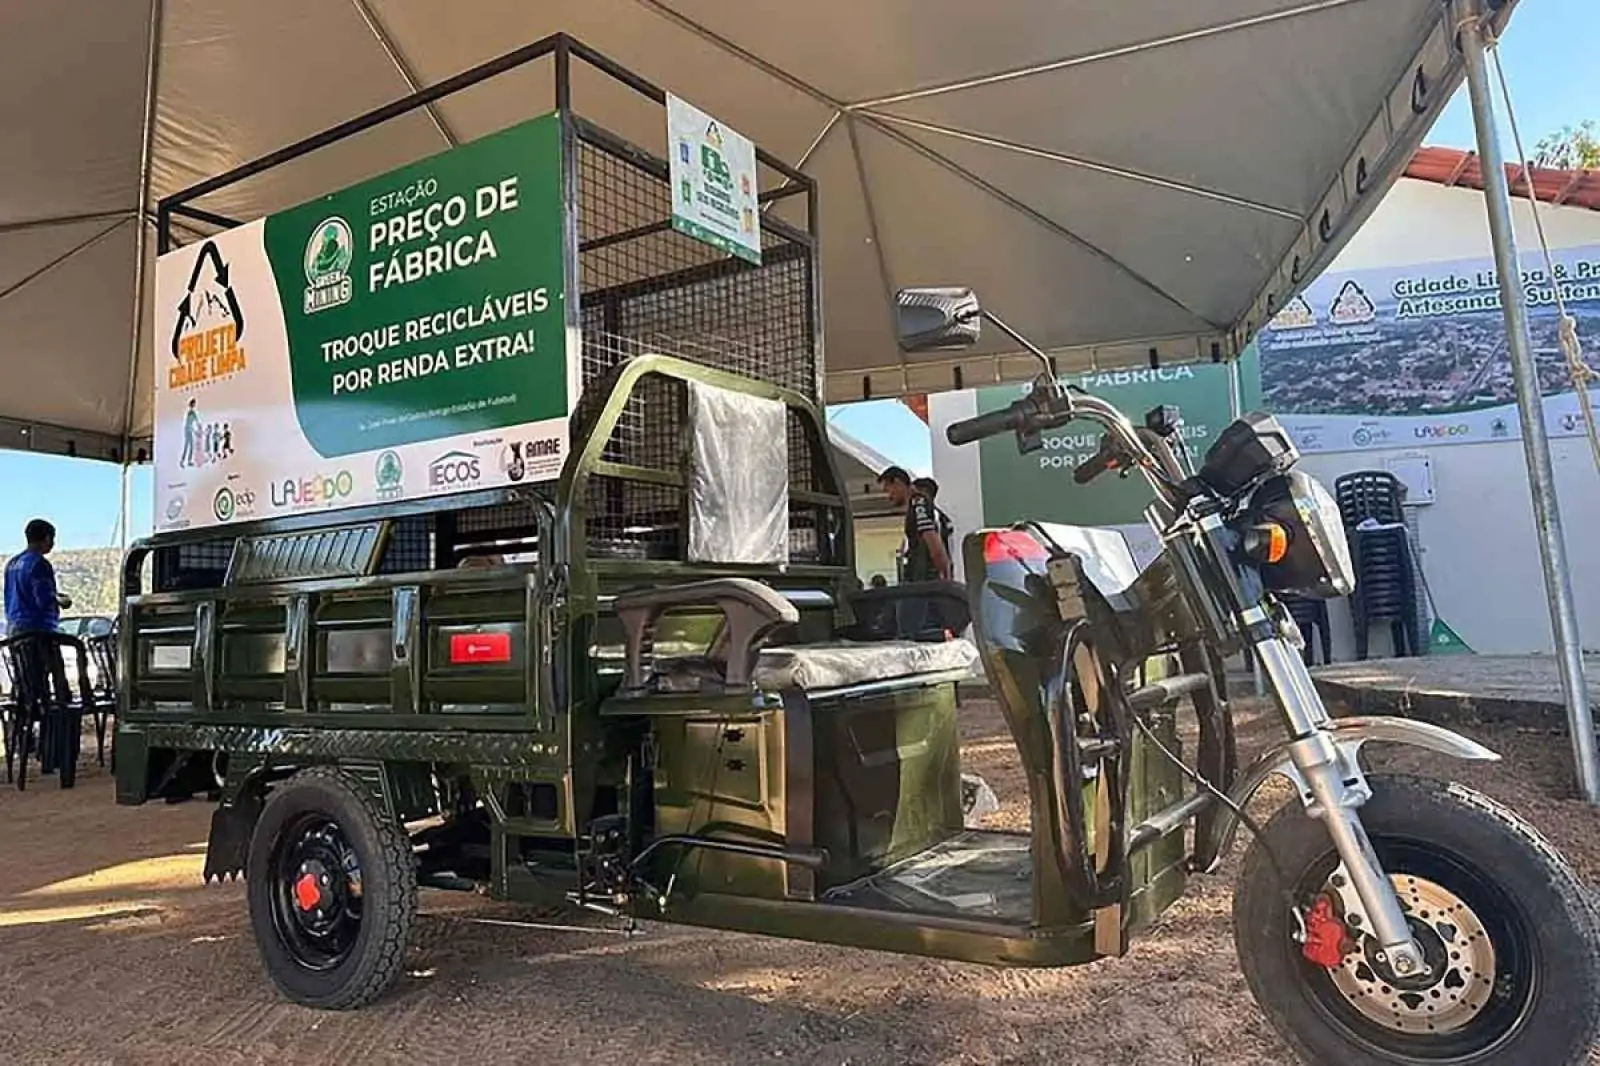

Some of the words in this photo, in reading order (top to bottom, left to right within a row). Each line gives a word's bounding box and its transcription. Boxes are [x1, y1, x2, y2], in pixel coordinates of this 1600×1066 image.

[370, 178, 438, 216] ESTAÇÃO
[370, 195, 466, 252] PREÇO
[475, 176, 519, 218] DE
[369, 230, 497, 293] FÁBRICA
[1394, 275, 1469, 295] Cidade
[1554, 264, 1568, 279] &
[1527, 285, 1600, 303] Suten
[320, 324, 400, 363] TROQUE
[405, 287, 549, 343] RECICLÁVEIS
[333, 369, 373, 395] POR
[378, 350, 450, 385] RENDA
[455, 329, 535, 368] EXTRA!
[434, 459, 481, 486] ECOS
[1040, 454, 1074, 469] POR
